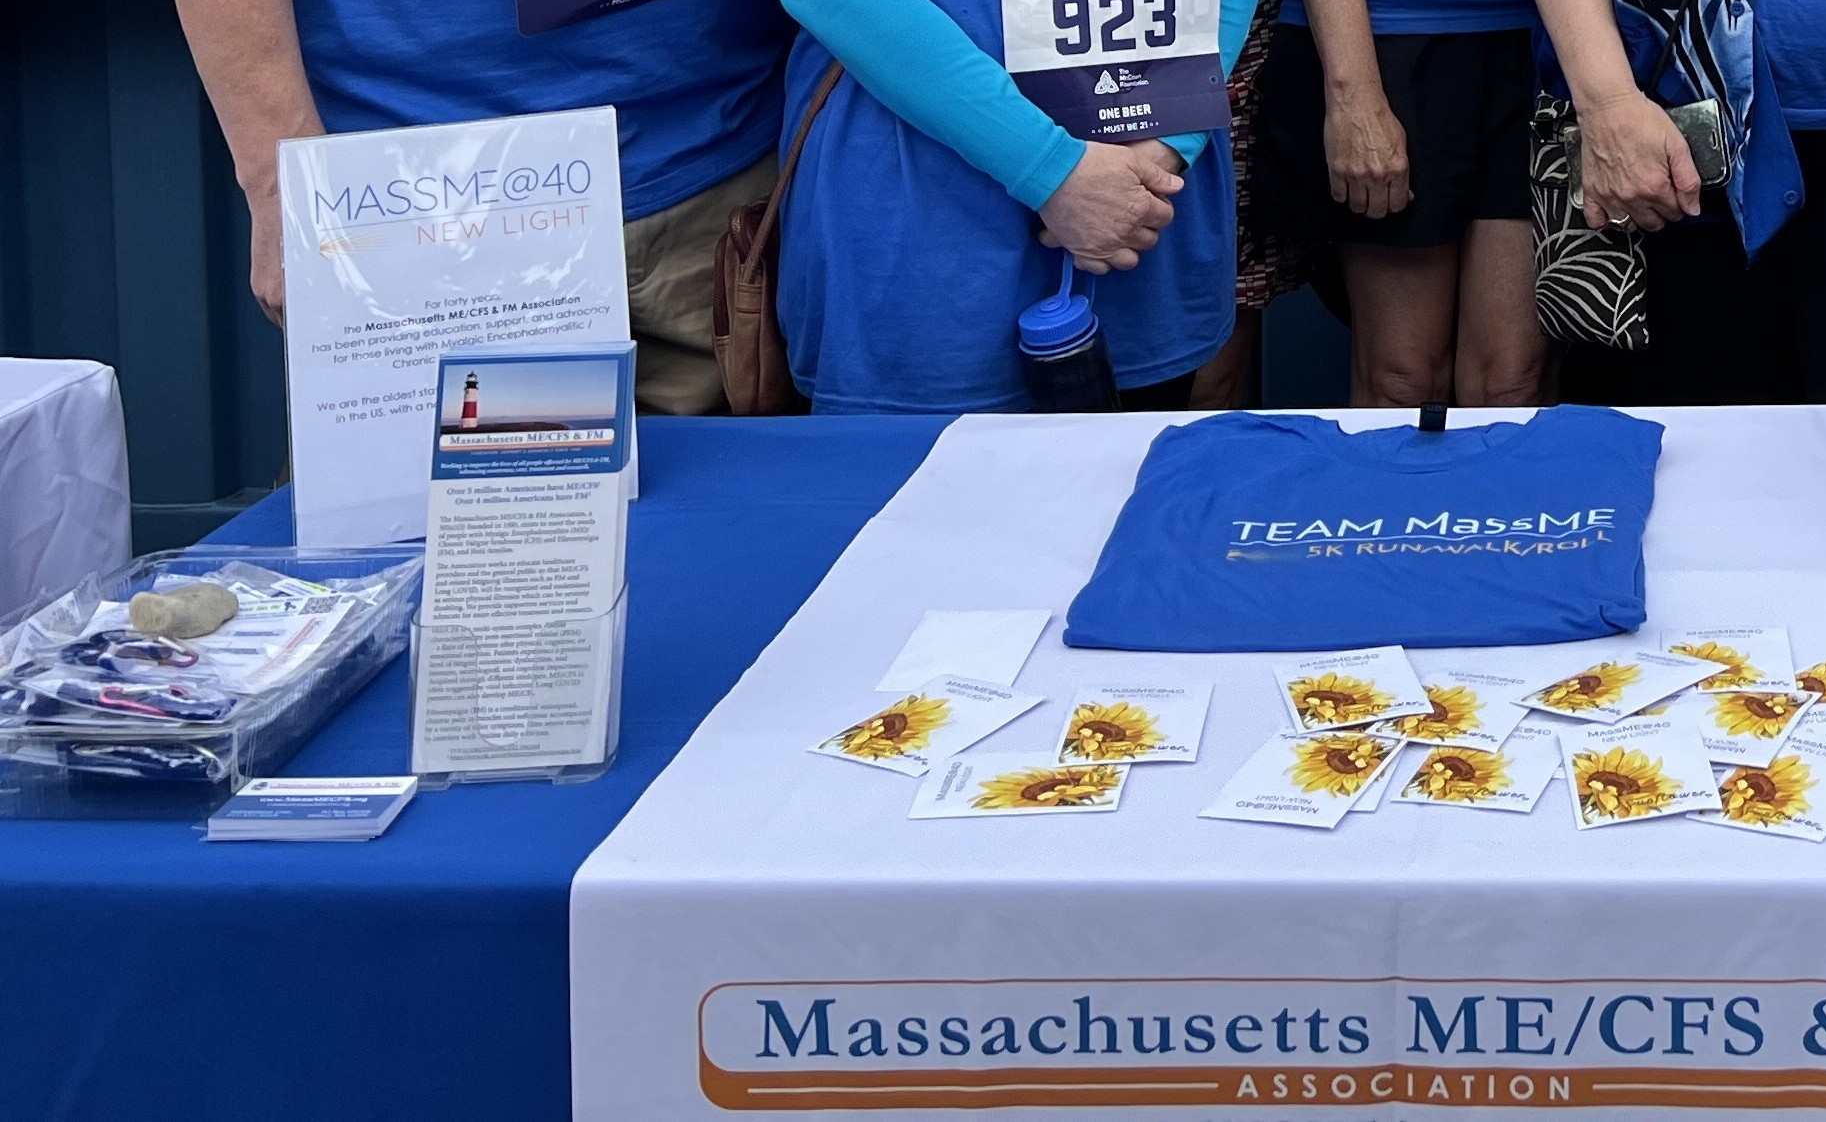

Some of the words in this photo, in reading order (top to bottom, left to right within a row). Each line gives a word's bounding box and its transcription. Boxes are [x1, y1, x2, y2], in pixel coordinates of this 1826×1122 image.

[1098, 108, 1121, 120] ONE
[1122, 104, 1152, 118] BEER
[1103, 123, 1125, 134] MUST
[1139, 121, 1149, 129] 21
[315, 159, 591, 224] MASSME@40
[418, 217, 487, 246] NEW
[503, 205, 591, 236] LIGHT
[444, 296, 468, 308] forty
[344, 324, 362, 334] the
[364, 313, 446, 332] Massachusetts
[448, 305, 490, 320] ME/CFS
[492, 304, 499, 313] &
[502, 302, 518, 312] FM
[520, 294, 581, 311] Association
[312, 342, 333, 353] has
[334, 337, 366, 350] been
[368, 329, 420, 349] providing
[532, 310, 554, 323] and
[333, 353, 349, 363] for
[351, 348, 382, 361] those
[384, 344, 413, 358] living
[415, 339, 439, 351] with
[392, 355, 436, 369] Chronic
[317, 400, 336, 412] We
[338, 398, 359, 410] are
[361, 394, 381, 406] the
[382, 389, 417, 403] oldest
[335, 413, 347, 424] in
[349, 409, 368, 421] the
[389, 402, 414, 415] with
[415, 404, 424, 412] a
[449, 434, 524, 445] Massachusetts
[586, 430, 604, 439] FM
[1232, 518, 1384, 541] TEAM
[1404, 509, 1616, 537] MassME
[1306, 544, 1344, 559] 5K
[755, 995, 1371, 1059] Massachusetts
[1405, 994, 1764, 1057] ME/CFS
[1236, 1072, 1572, 1101] ASSOCIATION
